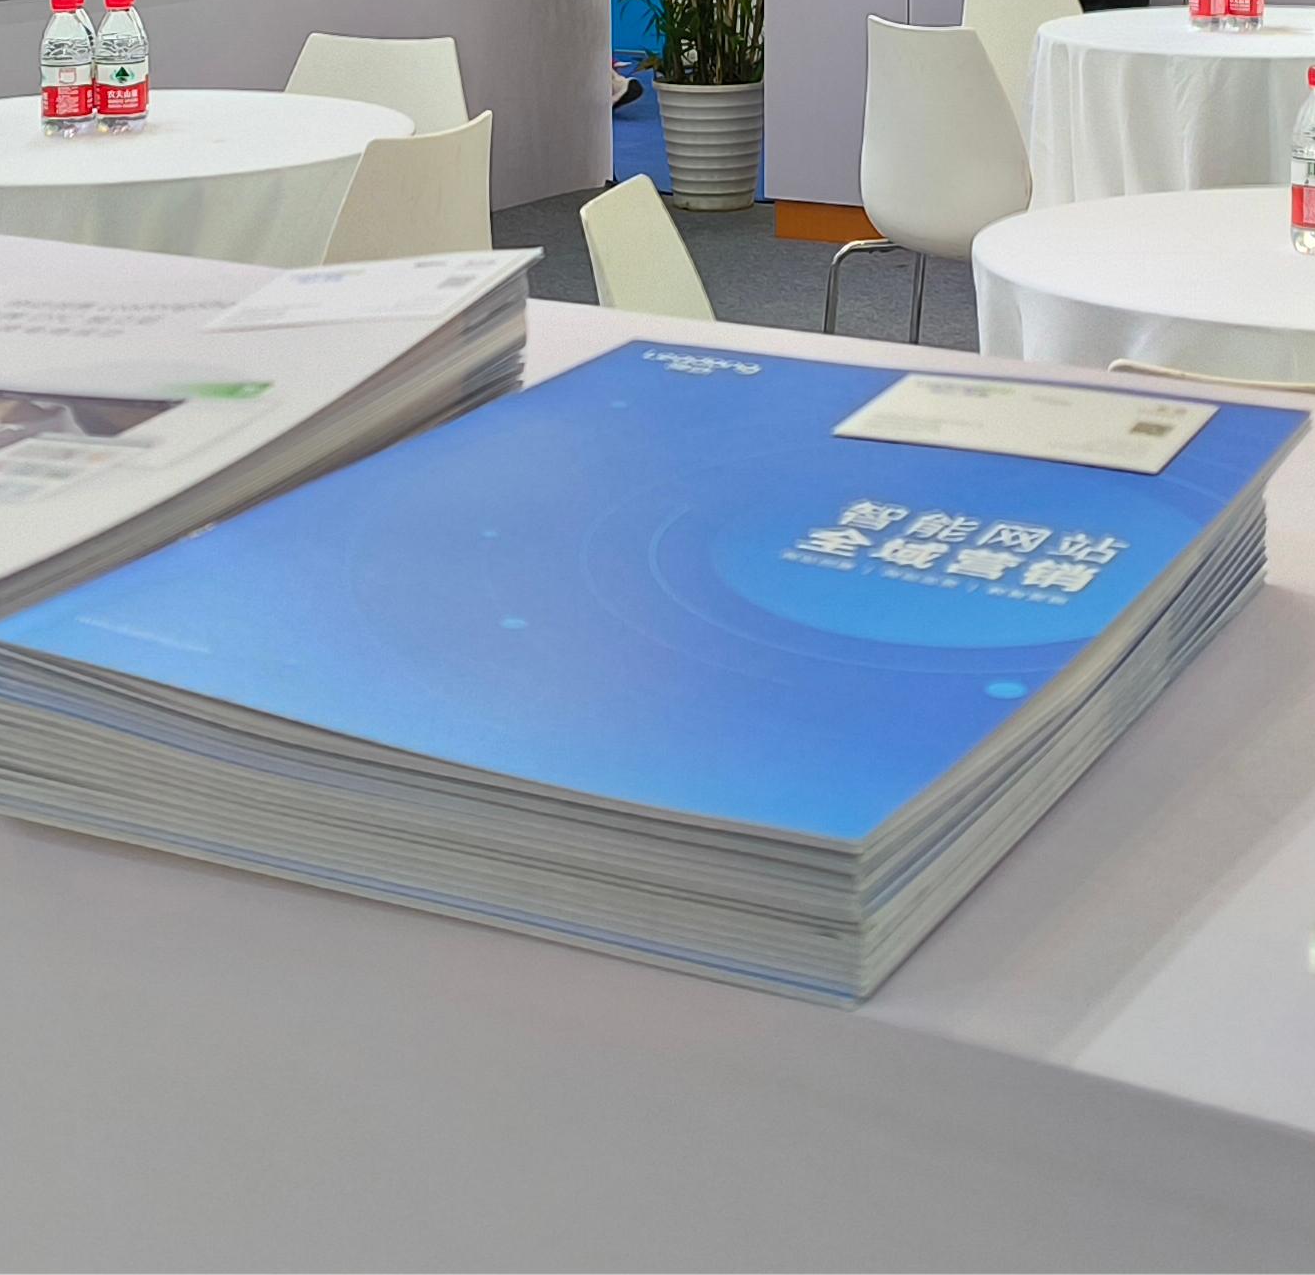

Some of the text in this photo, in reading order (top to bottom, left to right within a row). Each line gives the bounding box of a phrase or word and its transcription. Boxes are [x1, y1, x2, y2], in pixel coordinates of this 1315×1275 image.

[796, 527, 1100, 592] 全域营销
[839, 500, 1129, 565] 智能网站
